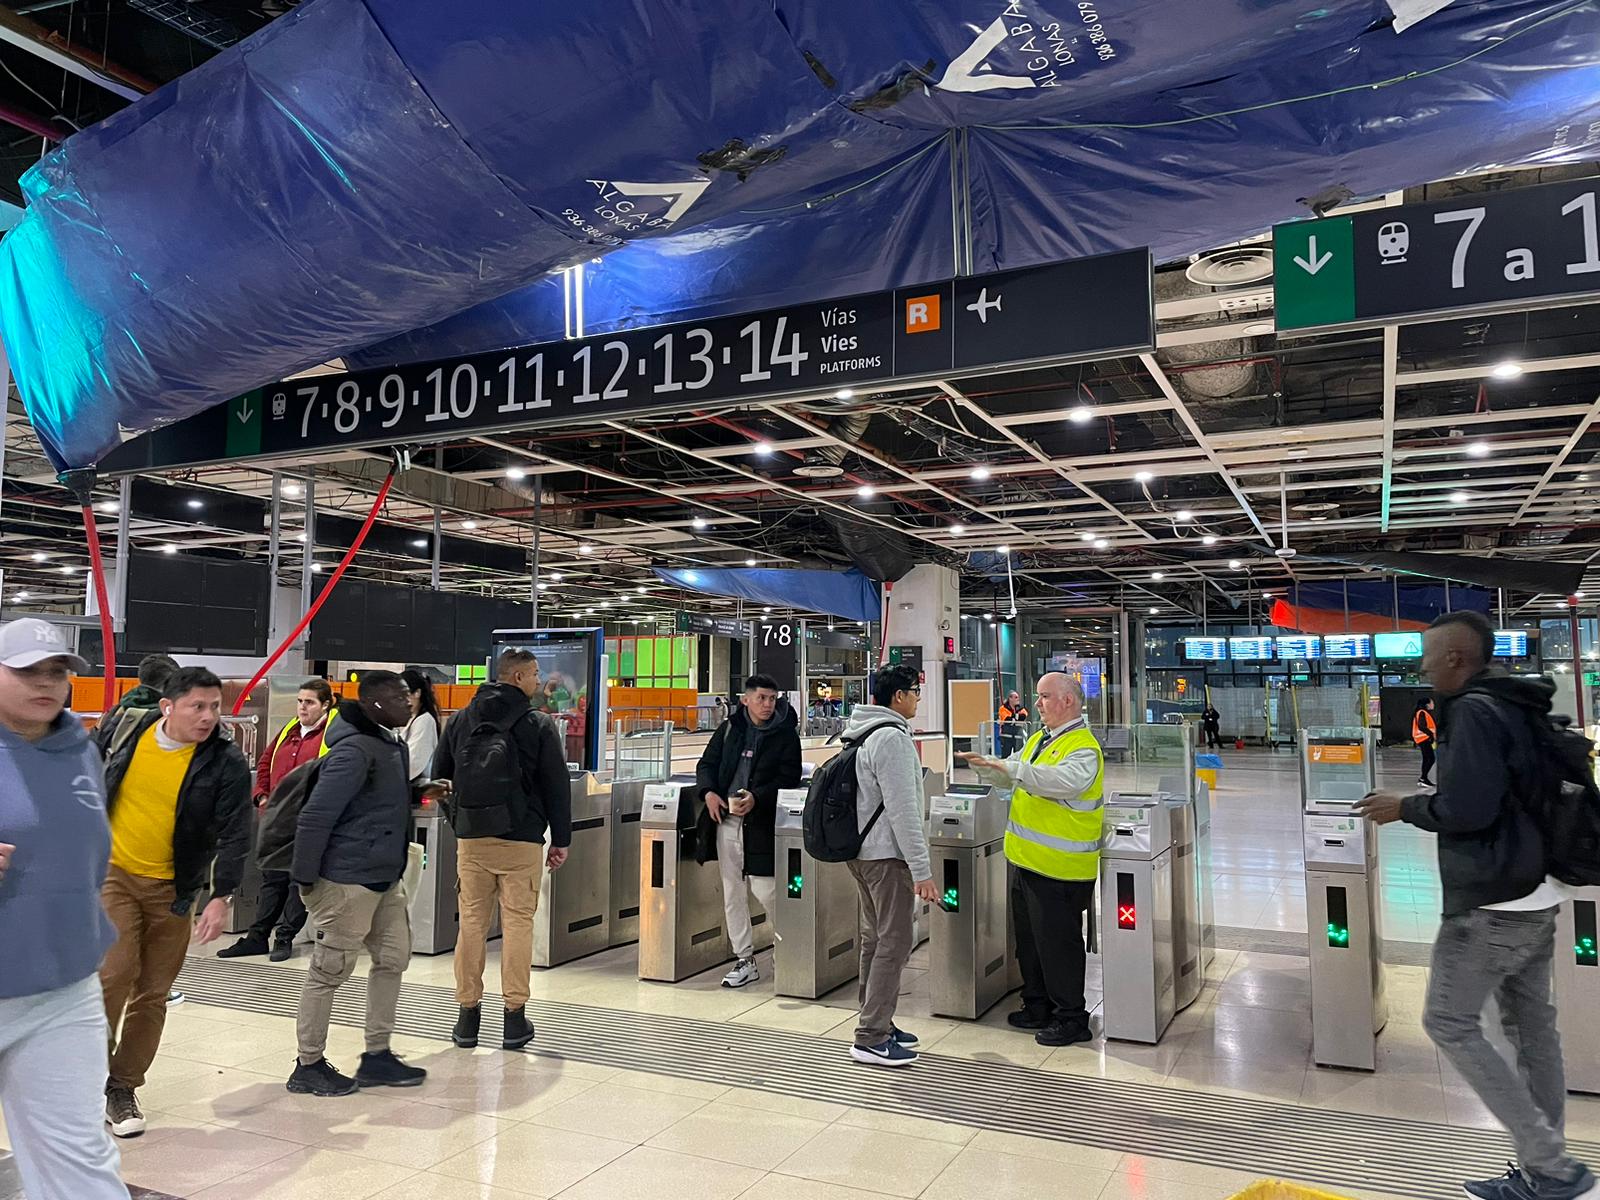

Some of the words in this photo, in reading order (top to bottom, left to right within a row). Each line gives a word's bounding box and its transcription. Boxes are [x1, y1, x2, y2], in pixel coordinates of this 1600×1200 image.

[1077, 2, 1099, 23] 079
[1002, 0, 1062, 88] ALGABA
[1041, 22, 1075, 67] LONAS
[1086, 23, 1107, 44] 386
[1095, 43, 1116, 61] 936
[585, 179, 675, 230] ALGABA
[561, 208, 586, 226] 936
[581, 224, 605, 238] 386
[593, 205, 640, 231] LONAS
[1434, 207, 1486, 289] 7
[1503, 248, 1535, 282] a
[821, 307, 857, 328] Vías
[909, 302, 928, 326] R
[821, 333, 858, 354] Vies
[820, 355, 882, 375] PLATFORMS
